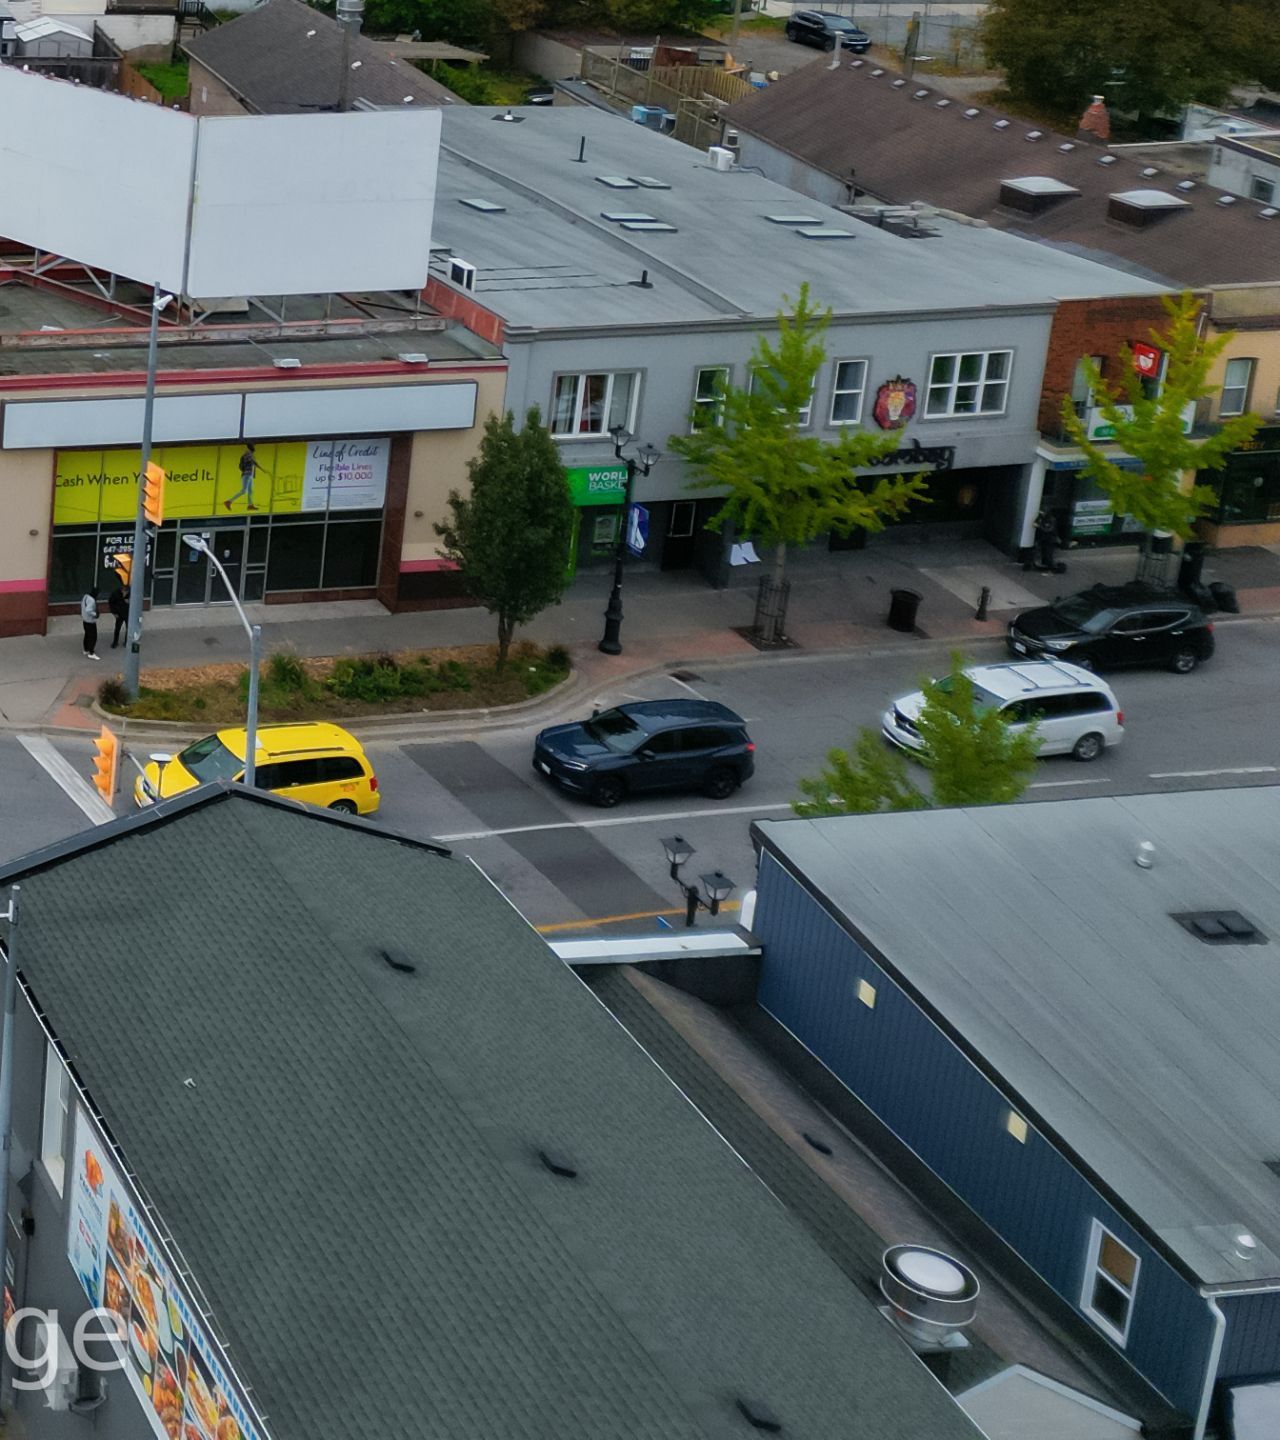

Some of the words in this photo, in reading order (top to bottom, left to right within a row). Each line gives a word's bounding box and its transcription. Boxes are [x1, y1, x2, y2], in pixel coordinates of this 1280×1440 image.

[335, 444, 346, 462] of
[348, 445, 379, 456] Credit
[55, 474, 84, 487] Cash
[87, 472, 129, 485] When
[588, 480, 625, 491] BASKE
[106, 536, 123, 544] FOR
